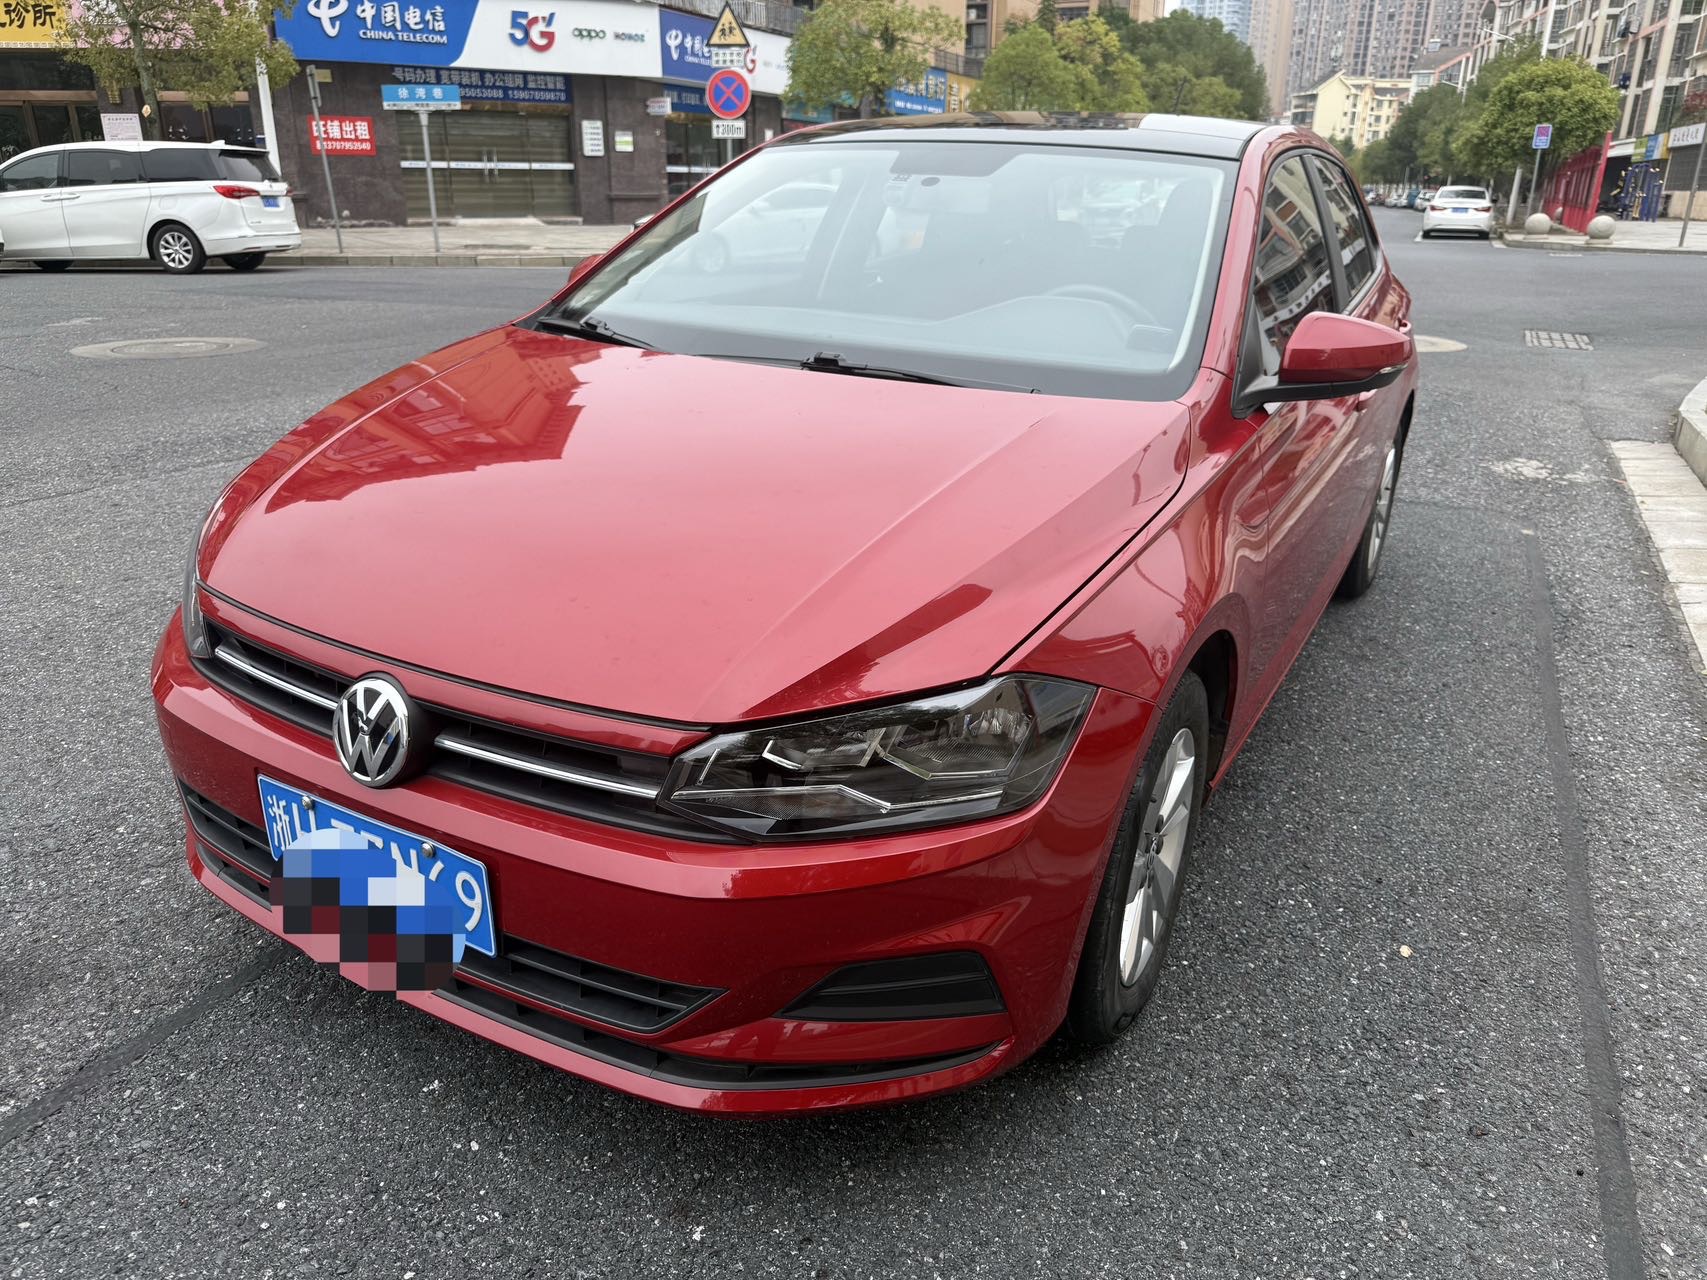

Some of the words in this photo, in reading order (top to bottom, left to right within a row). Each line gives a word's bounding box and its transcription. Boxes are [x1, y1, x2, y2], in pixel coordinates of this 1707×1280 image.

[0, 1, 57, 29] 诊所
[356, 0, 446, 32] 中国电信
[359, 29, 395, 41] CHINA
[397, 31, 448, 44] TELECOM
[508, 10, 556, 53] 5G
[392, 66, 437, 84] 号码办理
[311, 119, 371, 140] 旺铺出租
